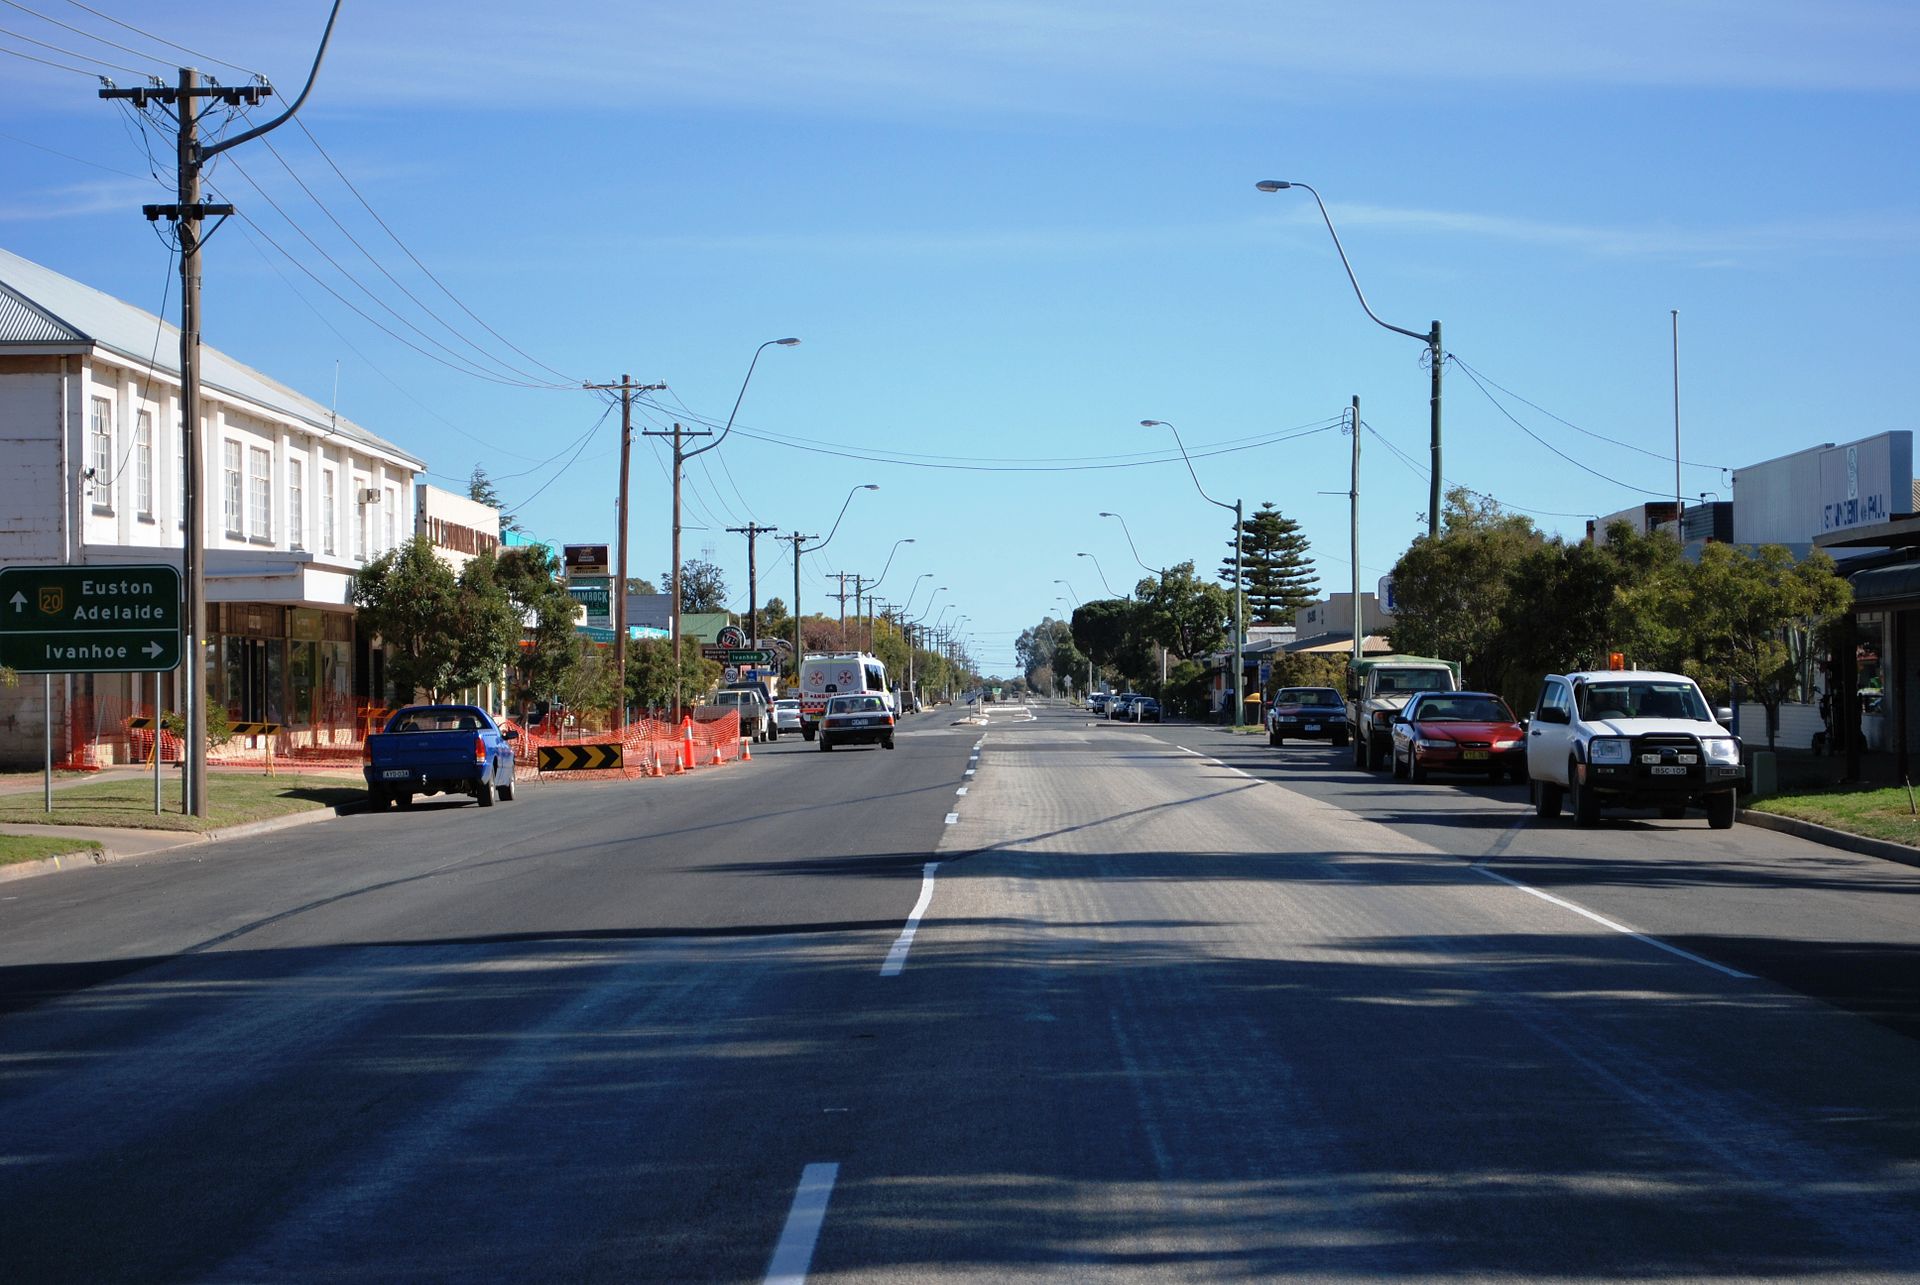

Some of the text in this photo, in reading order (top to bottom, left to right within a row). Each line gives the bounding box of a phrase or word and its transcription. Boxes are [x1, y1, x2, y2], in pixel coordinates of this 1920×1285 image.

[82, 580, 153, 595] Euston
[42, 594, 61, 609] 20
[73, 604, 164, 620] Adelaide
[724, 634, 737, 645] VB
[46, 644, 127, 659] Ivanhoe
[727, 672, 736, 680] 50
